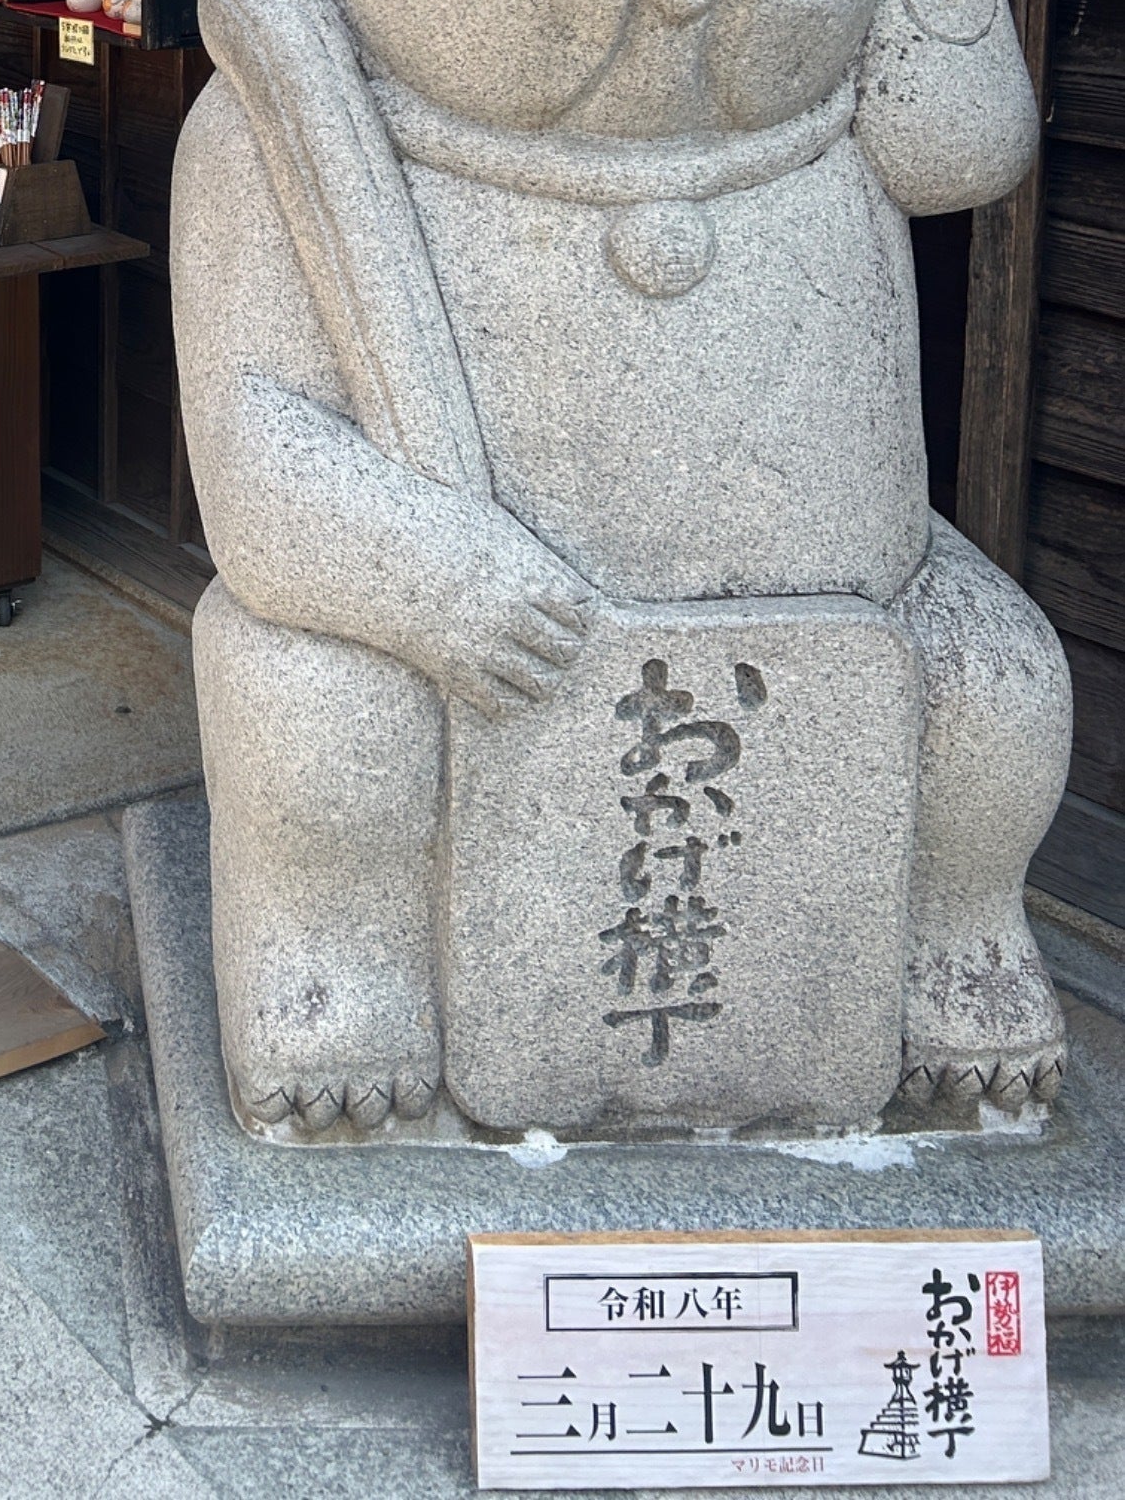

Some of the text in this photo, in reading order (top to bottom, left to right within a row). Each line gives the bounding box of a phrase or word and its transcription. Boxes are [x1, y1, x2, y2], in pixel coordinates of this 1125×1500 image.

[598, 658, 768, 1068] おかげ横丁
[598, 1285, 744, 1322] 令和八年
[987, 1272, 1020, 1354] 伊勢福
[515, 1361, 825, 1444] 三月二十九日
[921, 1267, 981, 1459] おかげ横丁
[730, 1456, 826, 1474] マリモ記念日
